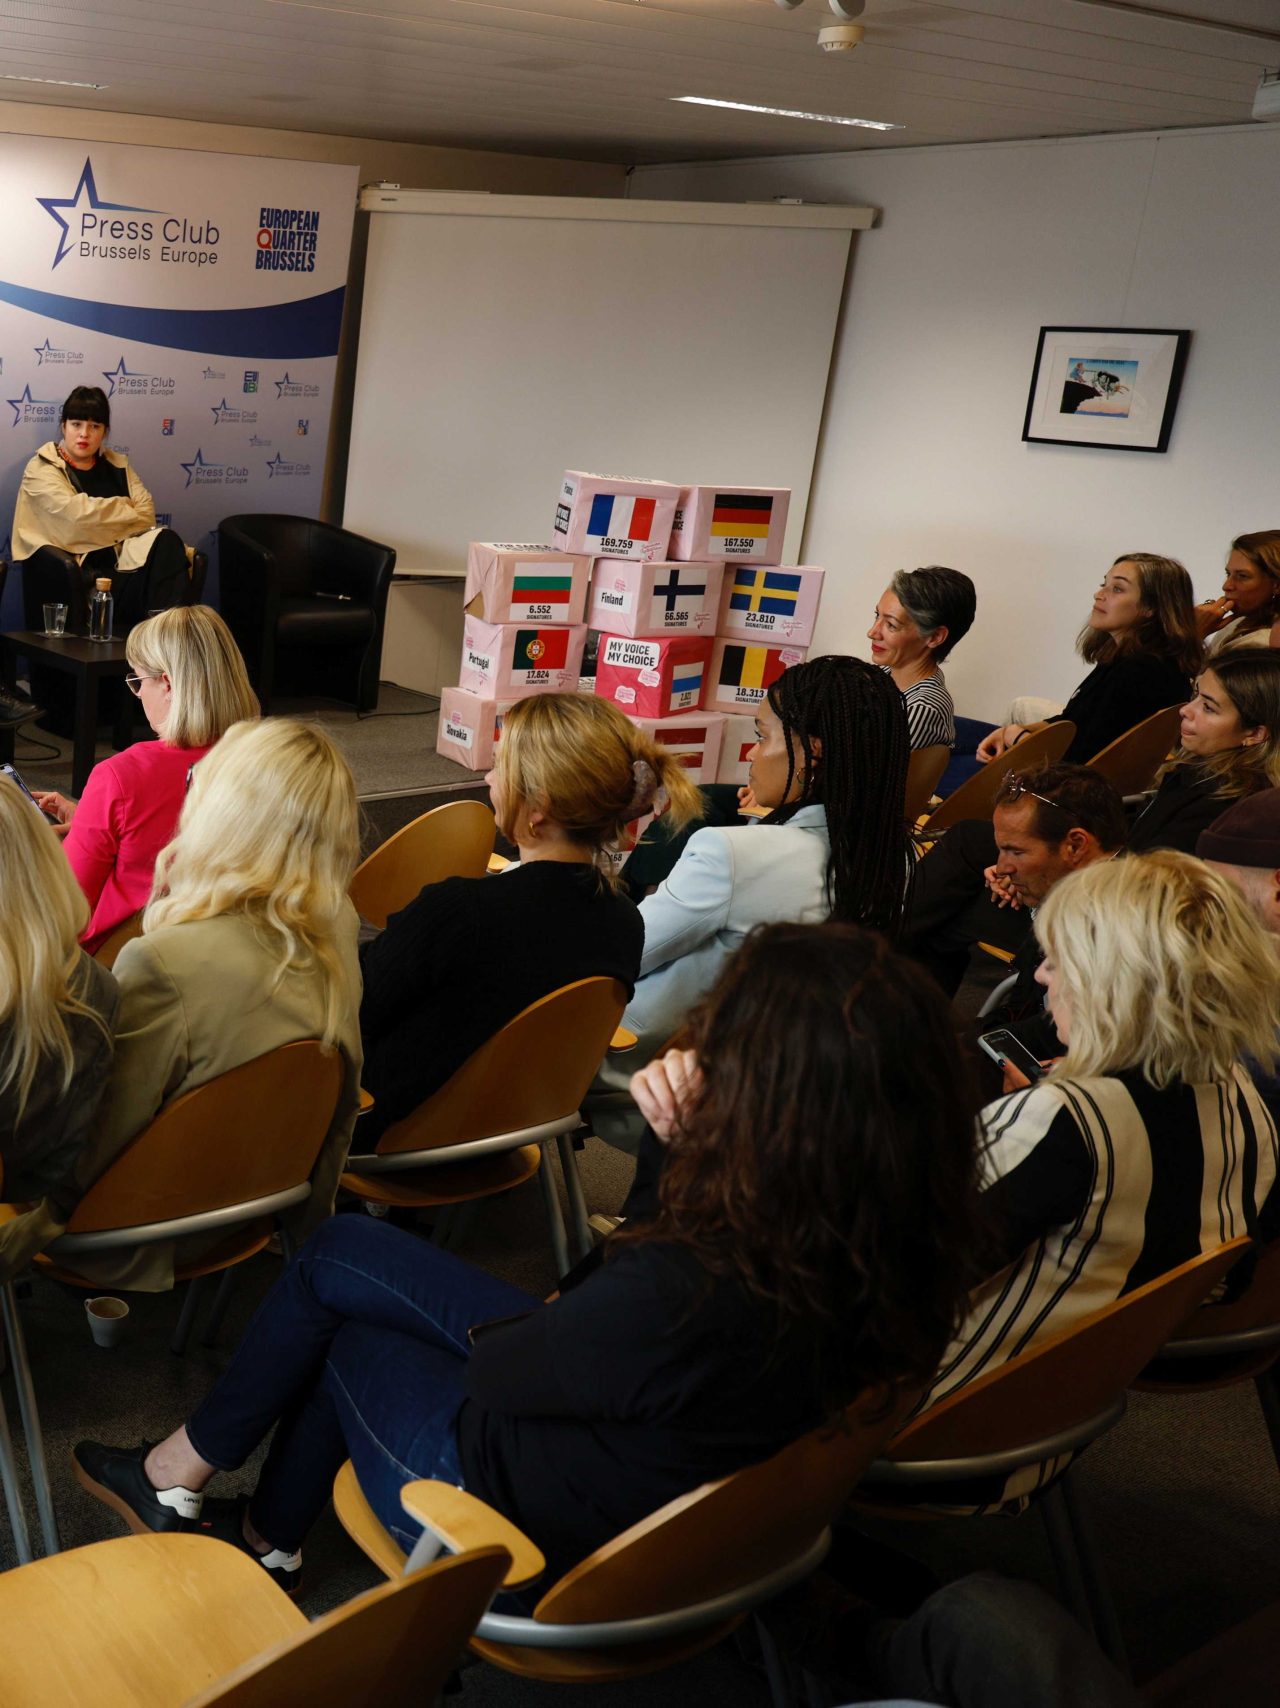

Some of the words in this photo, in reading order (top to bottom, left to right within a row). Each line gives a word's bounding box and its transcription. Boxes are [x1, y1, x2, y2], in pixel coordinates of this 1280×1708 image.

[259, 208, 320, 232] EUROPEAN
[81, 213, 153, 241] Press
[162, 219, 220, 245] Club
[257, 228, 316, 252] QUARTER
[80, 241, 151, 260] Brussels
[161, 247, 218, 267] Europe
[256, 250, 315, 272] BRUSSELS
[119, 377, 148, 387] Press
[151, 377, 175, 388] Club
[151, 388, 175, 397] Europe
[24, 404, 55, 415] Press
[24, 415, 54, 423] Brussels
[196, 467, 225, 477] Press
[226, 467, 248, 477] Club
[600, 537, 633, 549] 169.759
[724, 538, 754, 548] 167.550
[601, 547, 629, 555] SIGNATURES
[601, 592, 623, 606] Finland
[529, 605, 551, 614] 6.552
[665, 612, 688, 621] 66.565
[746, 613, 775, 624] 23.810
[745, 622, 773, 630] SIGNATURES
[610, 642, 623, 651] MY
[625, 643, 650, 655] VOICE
[469, 652, 489, 669] Portugal
[608, 652, 621, 661] MY
[623, 654, 655, 666] CHOICE
[526, 671, 549, 679] 17.824
[735, 688, 764, 698] 18.313
[735, 696, 761, 704] SIGNATURE
[447, 724, 467, 741] Slovakia
